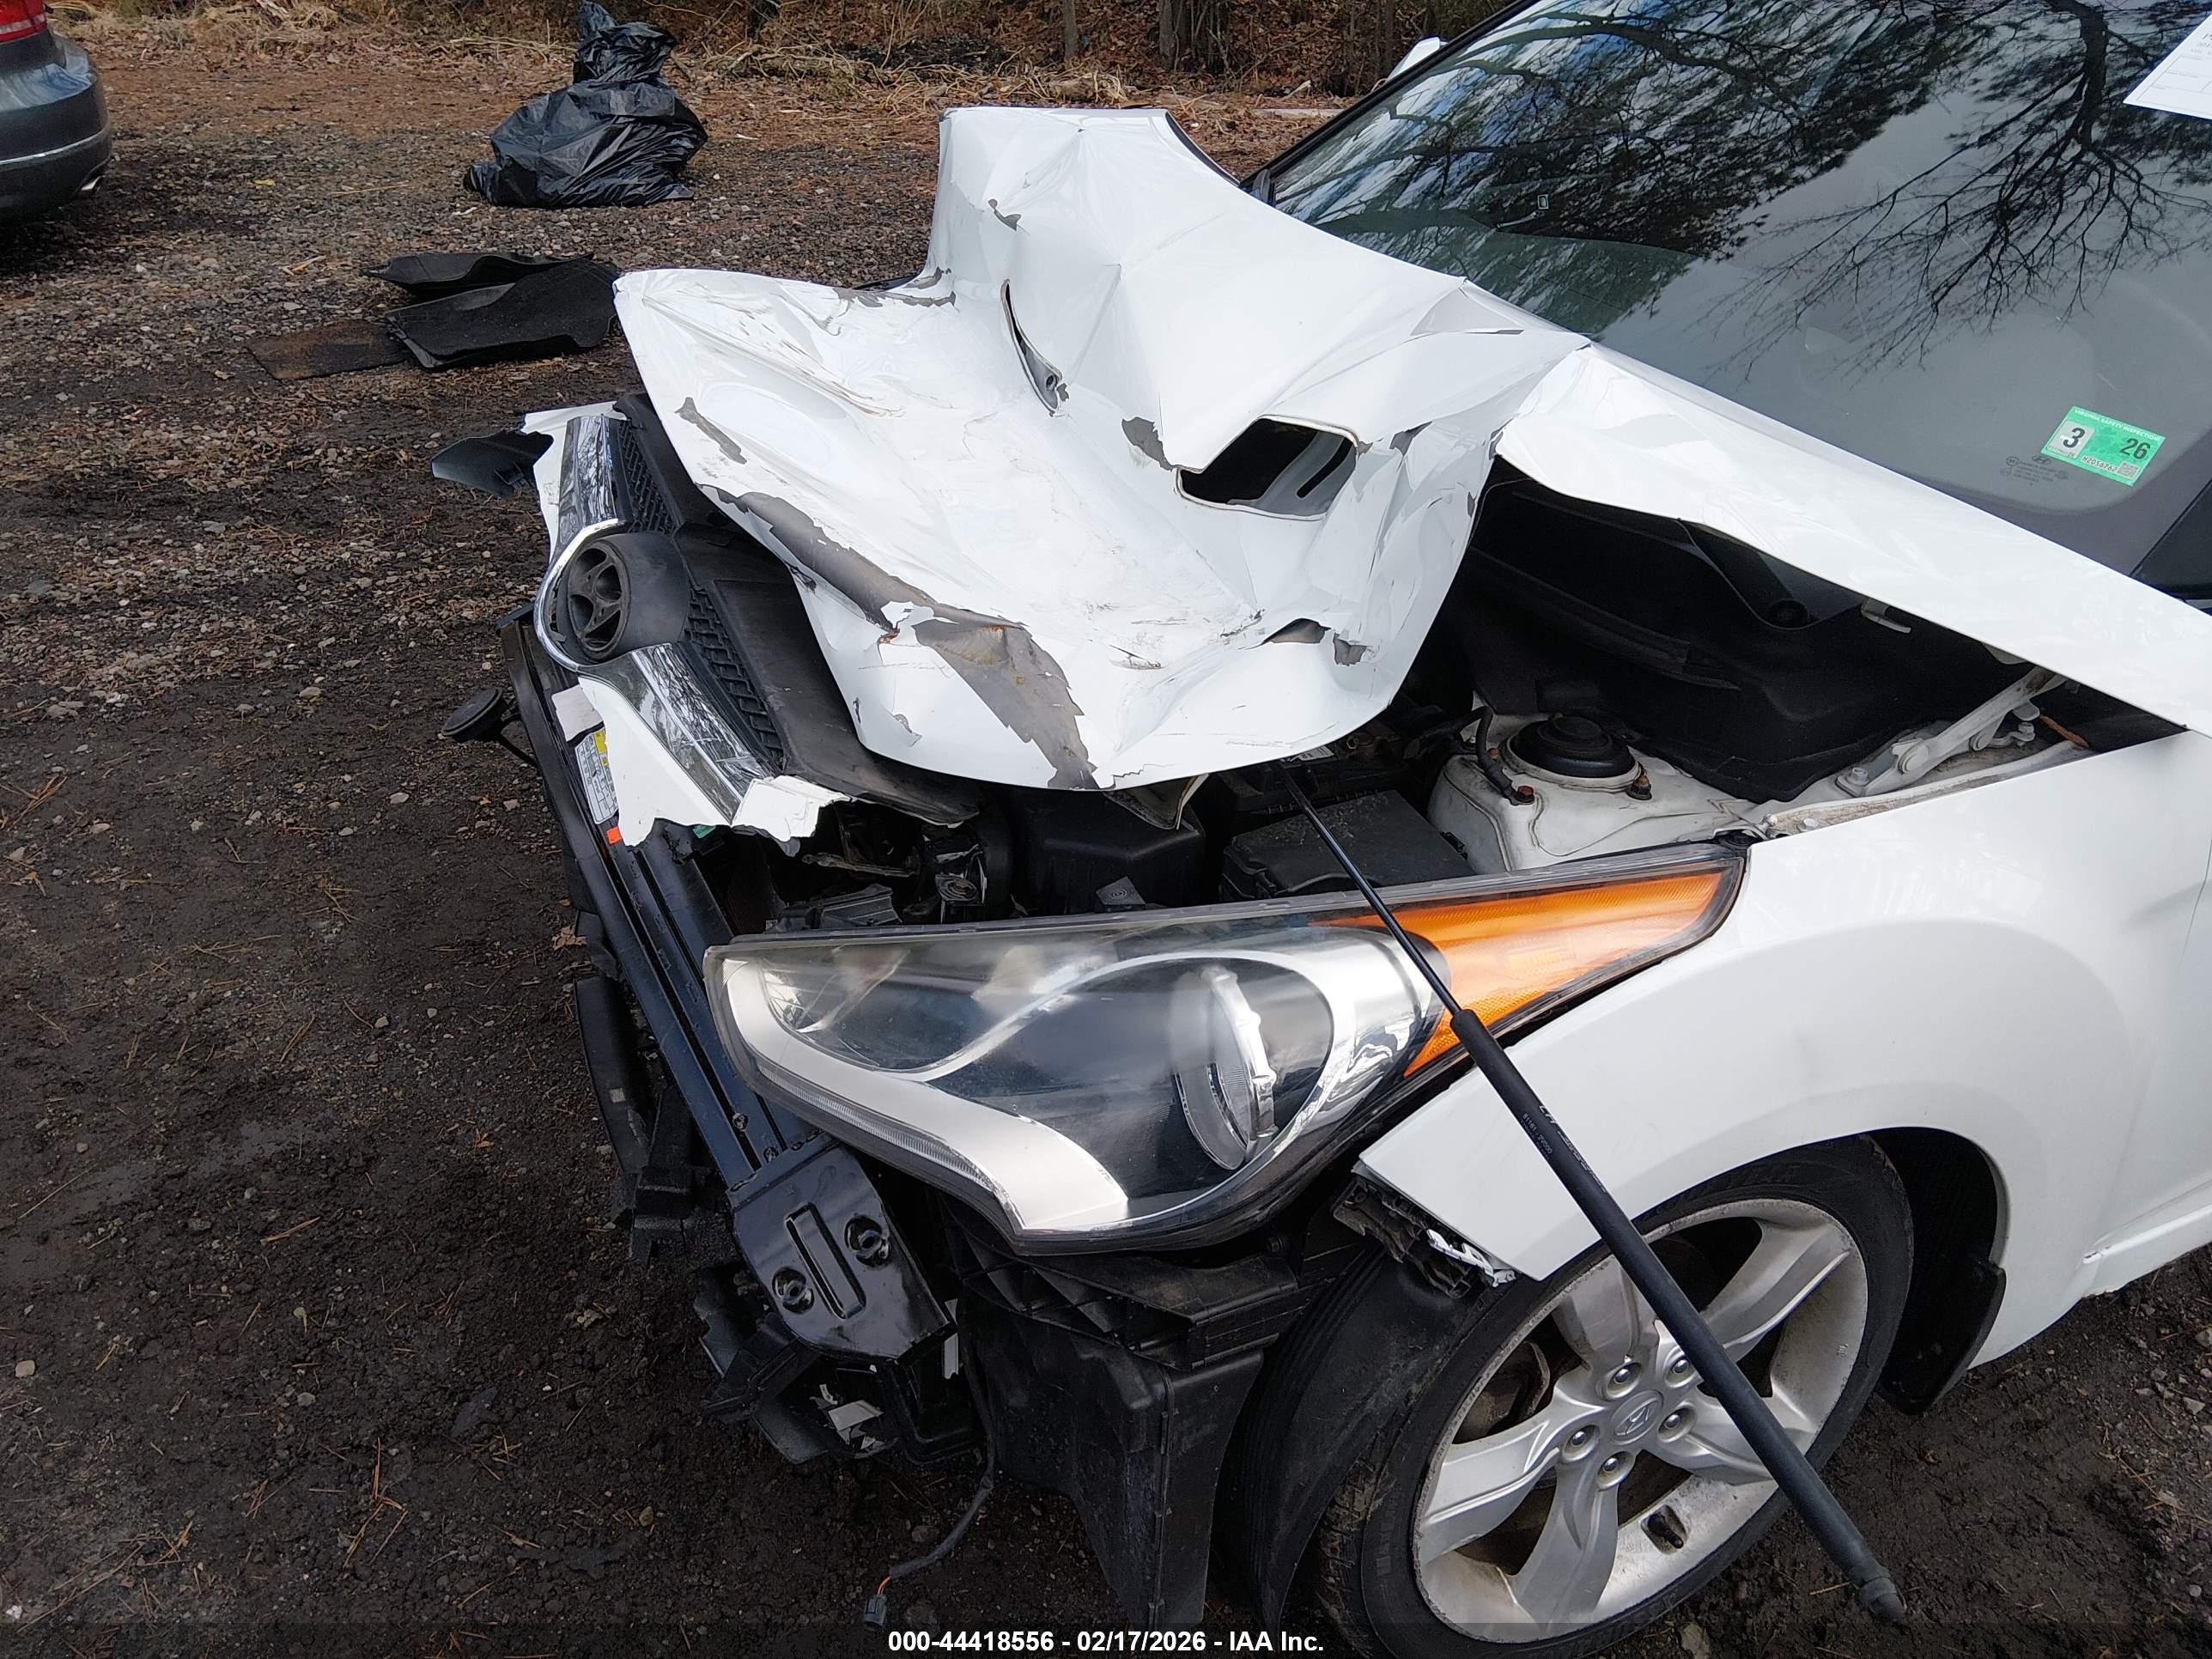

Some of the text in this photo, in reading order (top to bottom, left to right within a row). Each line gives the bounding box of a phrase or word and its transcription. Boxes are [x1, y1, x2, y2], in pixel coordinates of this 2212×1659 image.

[2063, 427, 2086, 448] 3
[2100, 417, 2123, 428] SAFETY
[2123, 423, 2160, 441] INSPECTION
[2119, 438, 2151, 459] 26
